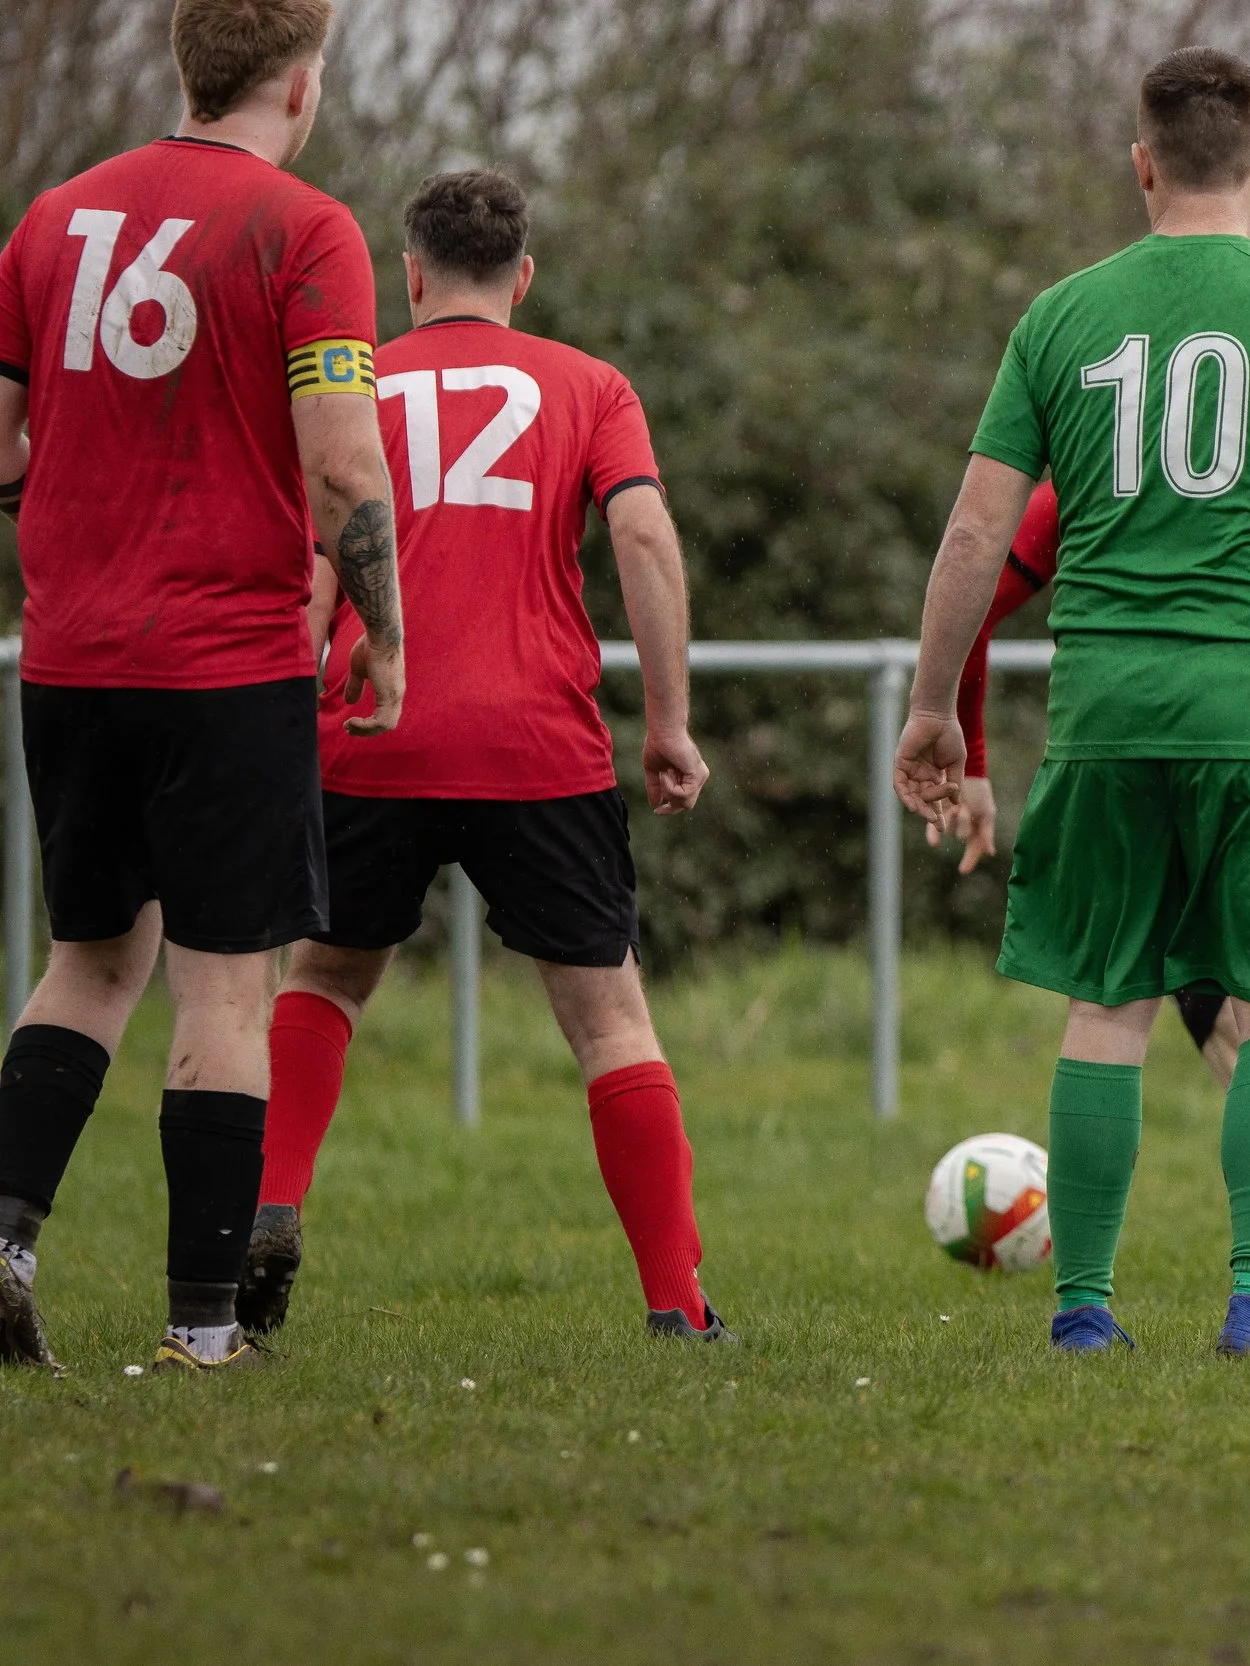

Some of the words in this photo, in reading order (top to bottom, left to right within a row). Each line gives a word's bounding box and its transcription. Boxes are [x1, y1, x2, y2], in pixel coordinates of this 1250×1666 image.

[63, 208, 197, 379] 16
[322, 347, 355, 383] C
[377, 365, 542, 512] 12
[1080, 331, 1250, 499] 10
